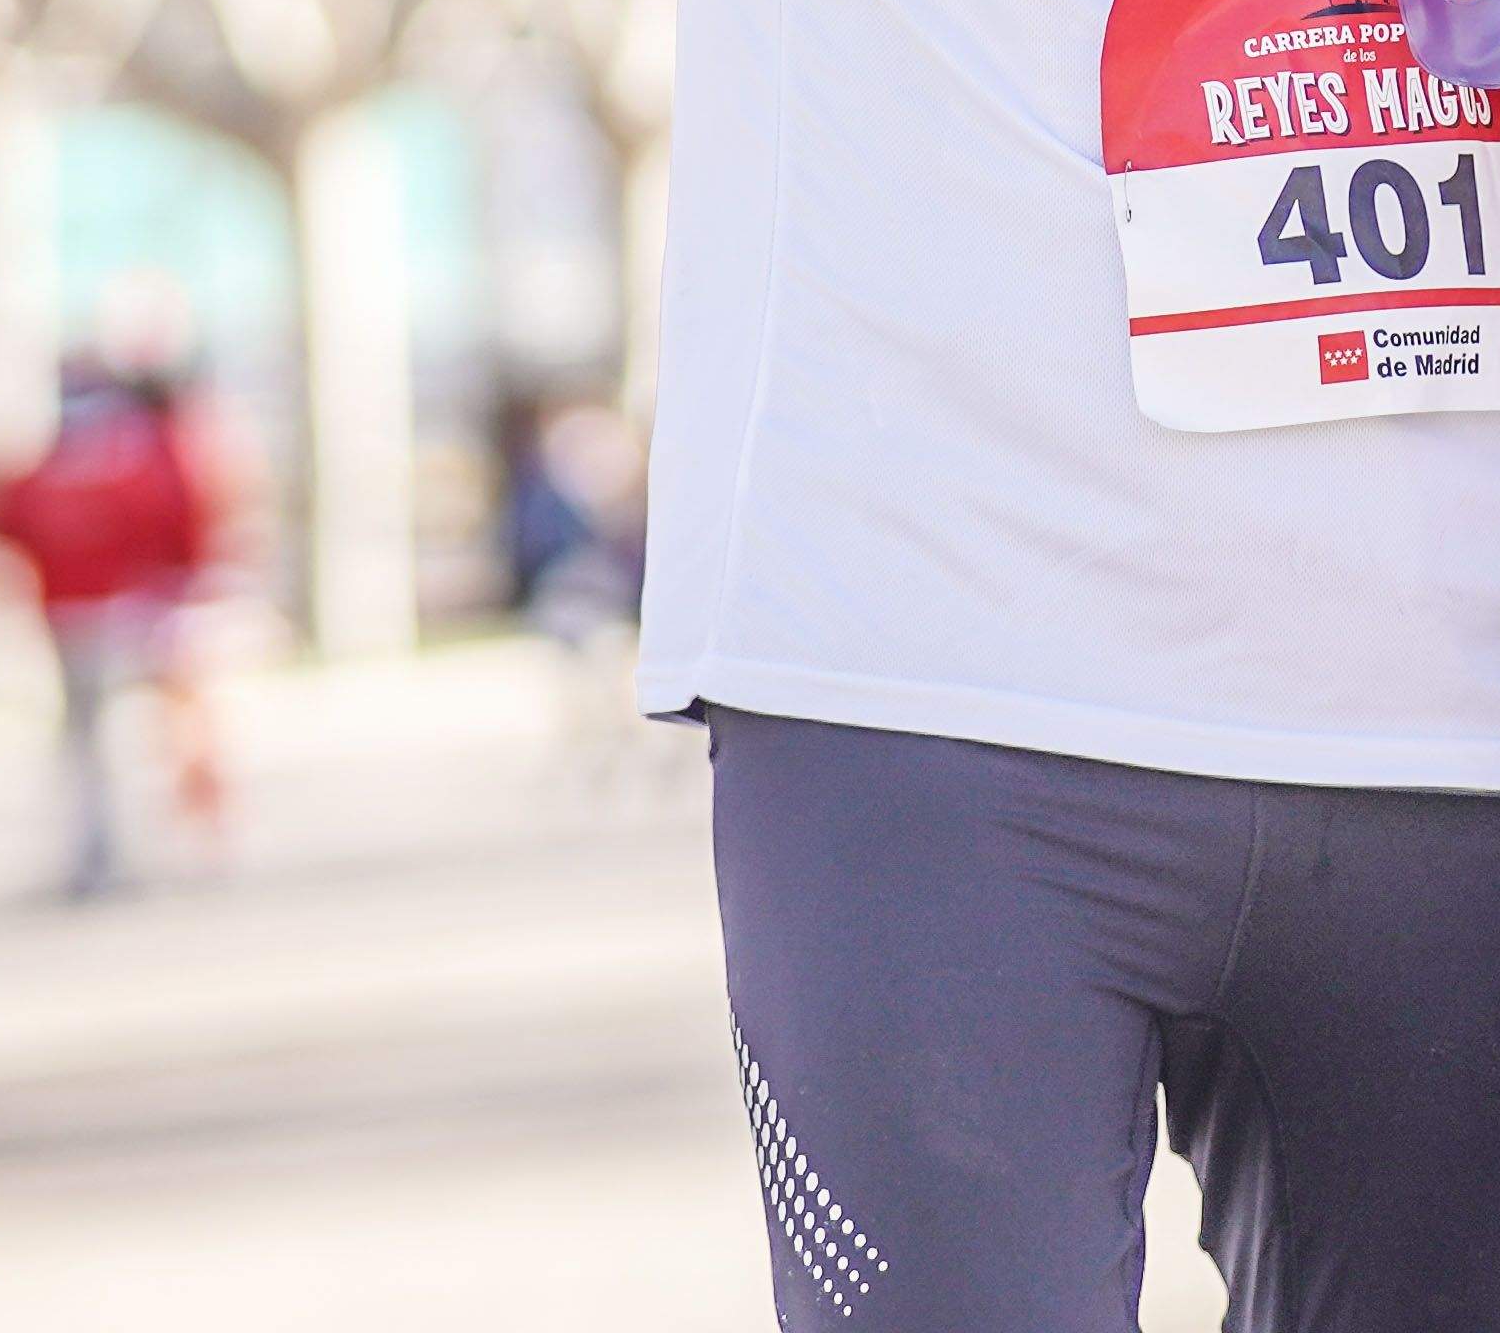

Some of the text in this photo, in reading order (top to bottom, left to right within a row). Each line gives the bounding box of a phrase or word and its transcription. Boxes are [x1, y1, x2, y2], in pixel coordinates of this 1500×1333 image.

[1243, 22, 1406, 58] CARRERA POP
[1343, 48, 1377, 63] de los
[1200, 70, 1351, 146] REYES
[1257, 154, 1486, 285] 401
[1373, 325, 1481, 348] Comunidad
[1377, 353, 1480, 378] de Madrid
